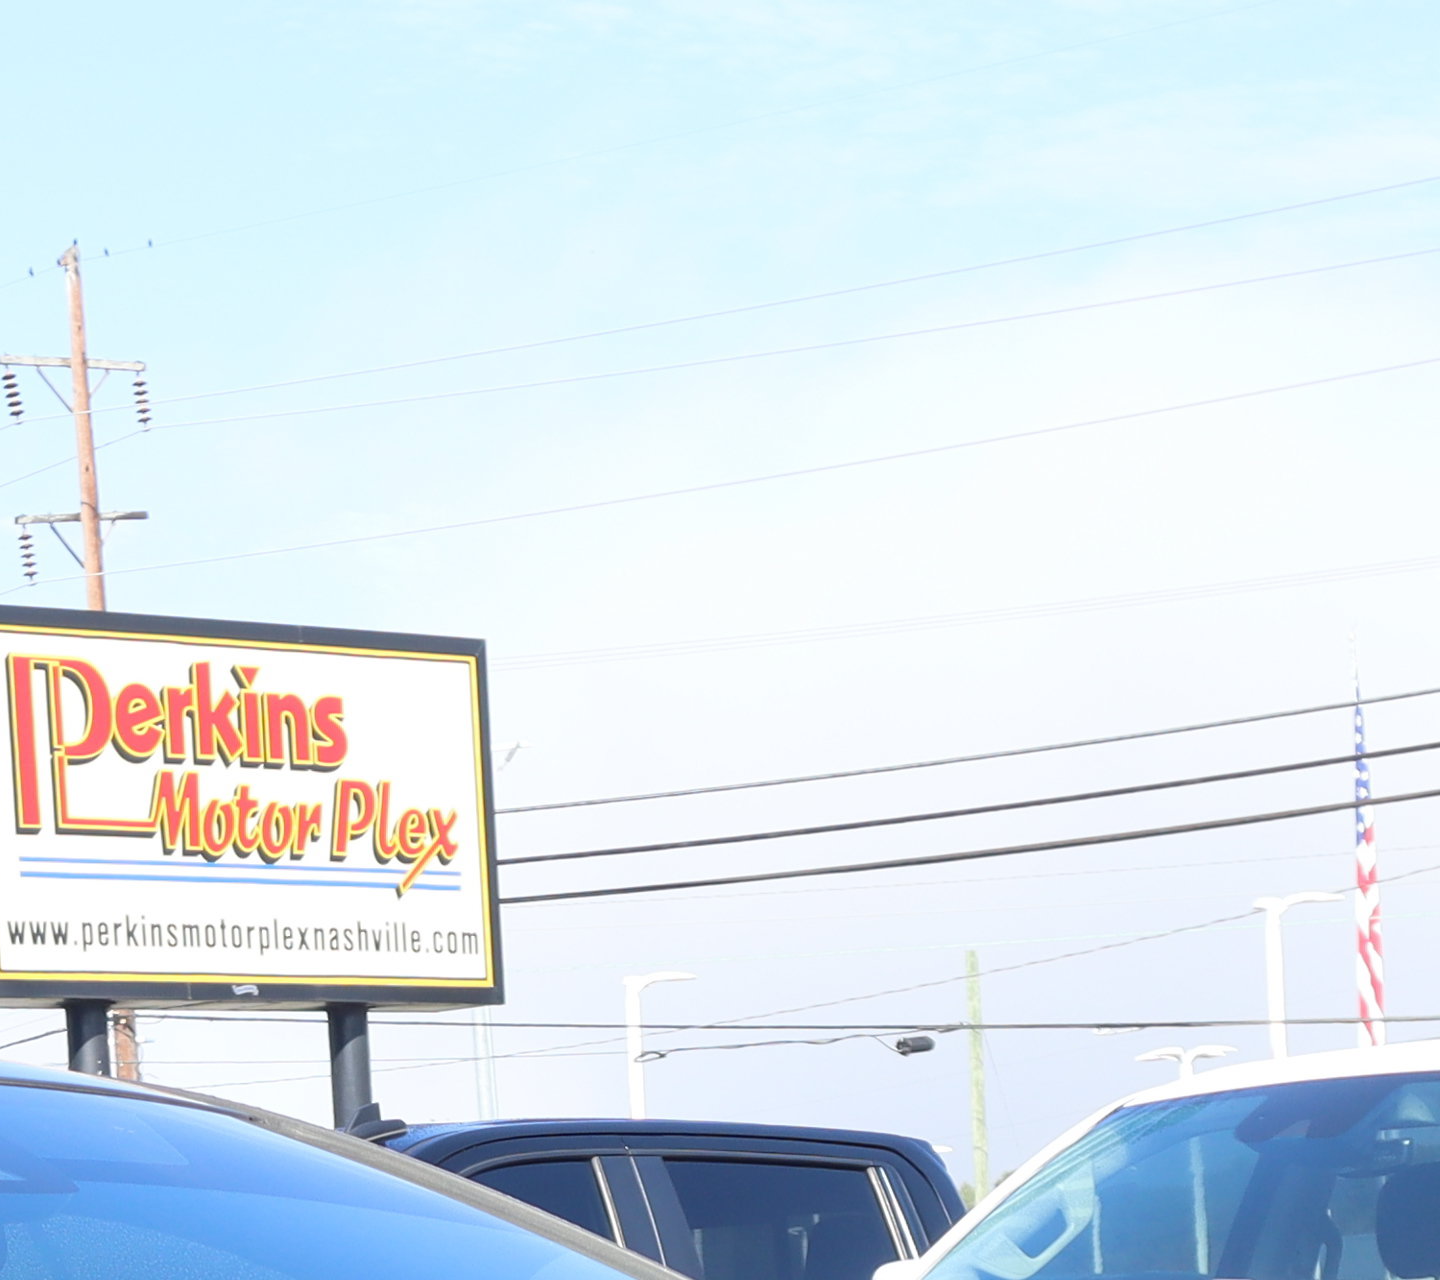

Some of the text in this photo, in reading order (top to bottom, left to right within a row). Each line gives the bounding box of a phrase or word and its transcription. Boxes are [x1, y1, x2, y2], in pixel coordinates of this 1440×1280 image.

[7, 653, 349, 833] Perkins
[151, 771, 459, 897] Motor Plex
[7, 915, 479, 955] www.perkinsmotorplexnashville.com
